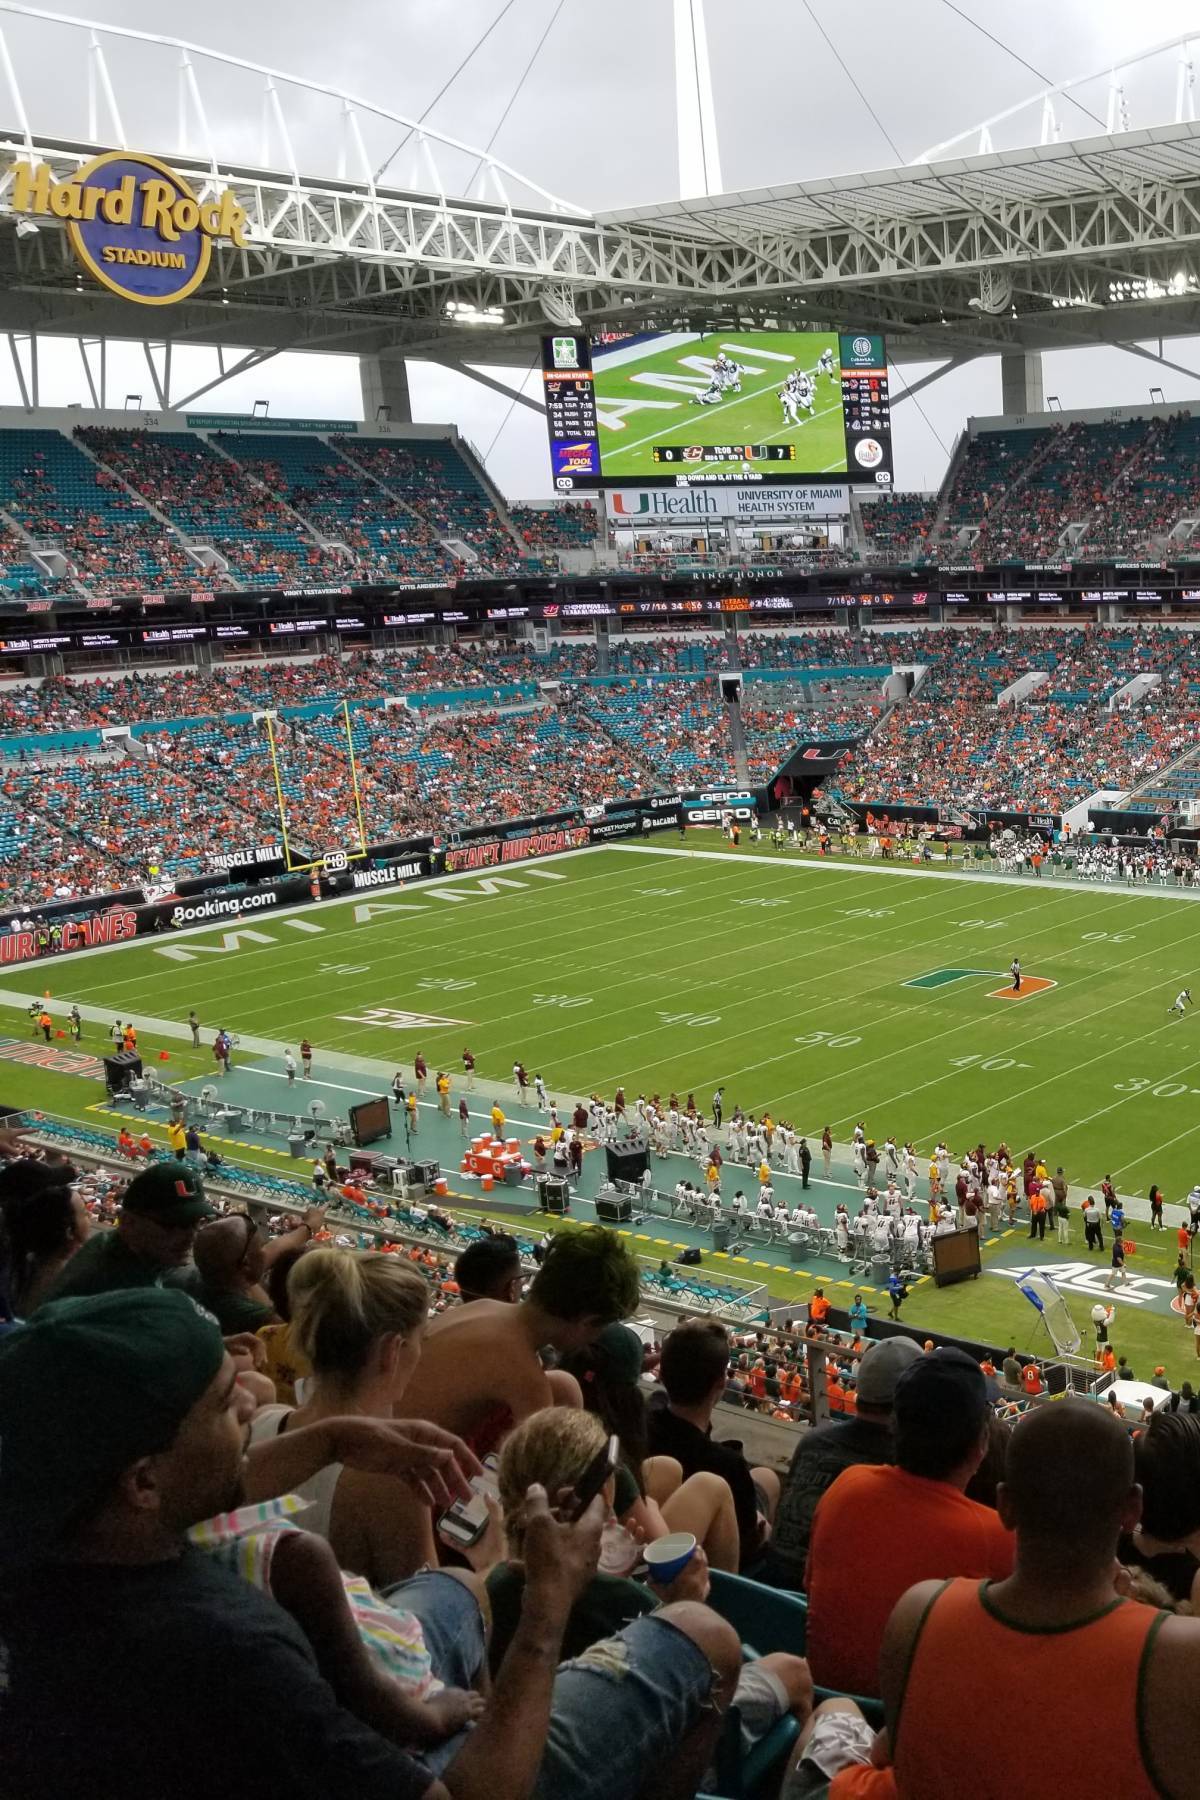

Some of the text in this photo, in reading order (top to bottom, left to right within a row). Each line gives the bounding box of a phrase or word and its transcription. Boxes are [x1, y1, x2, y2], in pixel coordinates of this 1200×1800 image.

[9, 160, 248, 248] Hard Rock
[102, 246, 187, 269] STADIUM
[144, 418, 159, 427] 334
[665, 450, 673, 460] 0
[777, 448, 784, 459] 7
[568, 457, 592, 465] TOOL
[558, 479, 571, 487] CC
[876, 473, 890, 481] CC
[737, 488, 843, 501] UNIVERSITY OF MIAMI
[738, 501, 815, 513] HEALTH SYSTEM
[693, 570, 784, 580] RING HONOR
[700, 791, 751, 802] GEICO
[593, 825, 615, 835] ROCKET
[615, 821, 637, 832] Mortgage
[210, 845, 283, 870] MUSCLE MILK
[354, 862, 422, 889] MUSCLE MILK
[174, 890, 277, 922] Booking.com
[328, 963, 370, 976] 10
[424, 977, 478, 992] 20
[541, 993, 594, 1009] 30
[660, 1011, 722, 1028] 40
[794, 1031, 863, 1048] 50
[948, 1054, 1018, 1071] 40
[1113, 1077, 1189, 1097] 30
[985, 1262, 1178, 1304] ACC
[1027, 1370, 1034, 1381] 8
